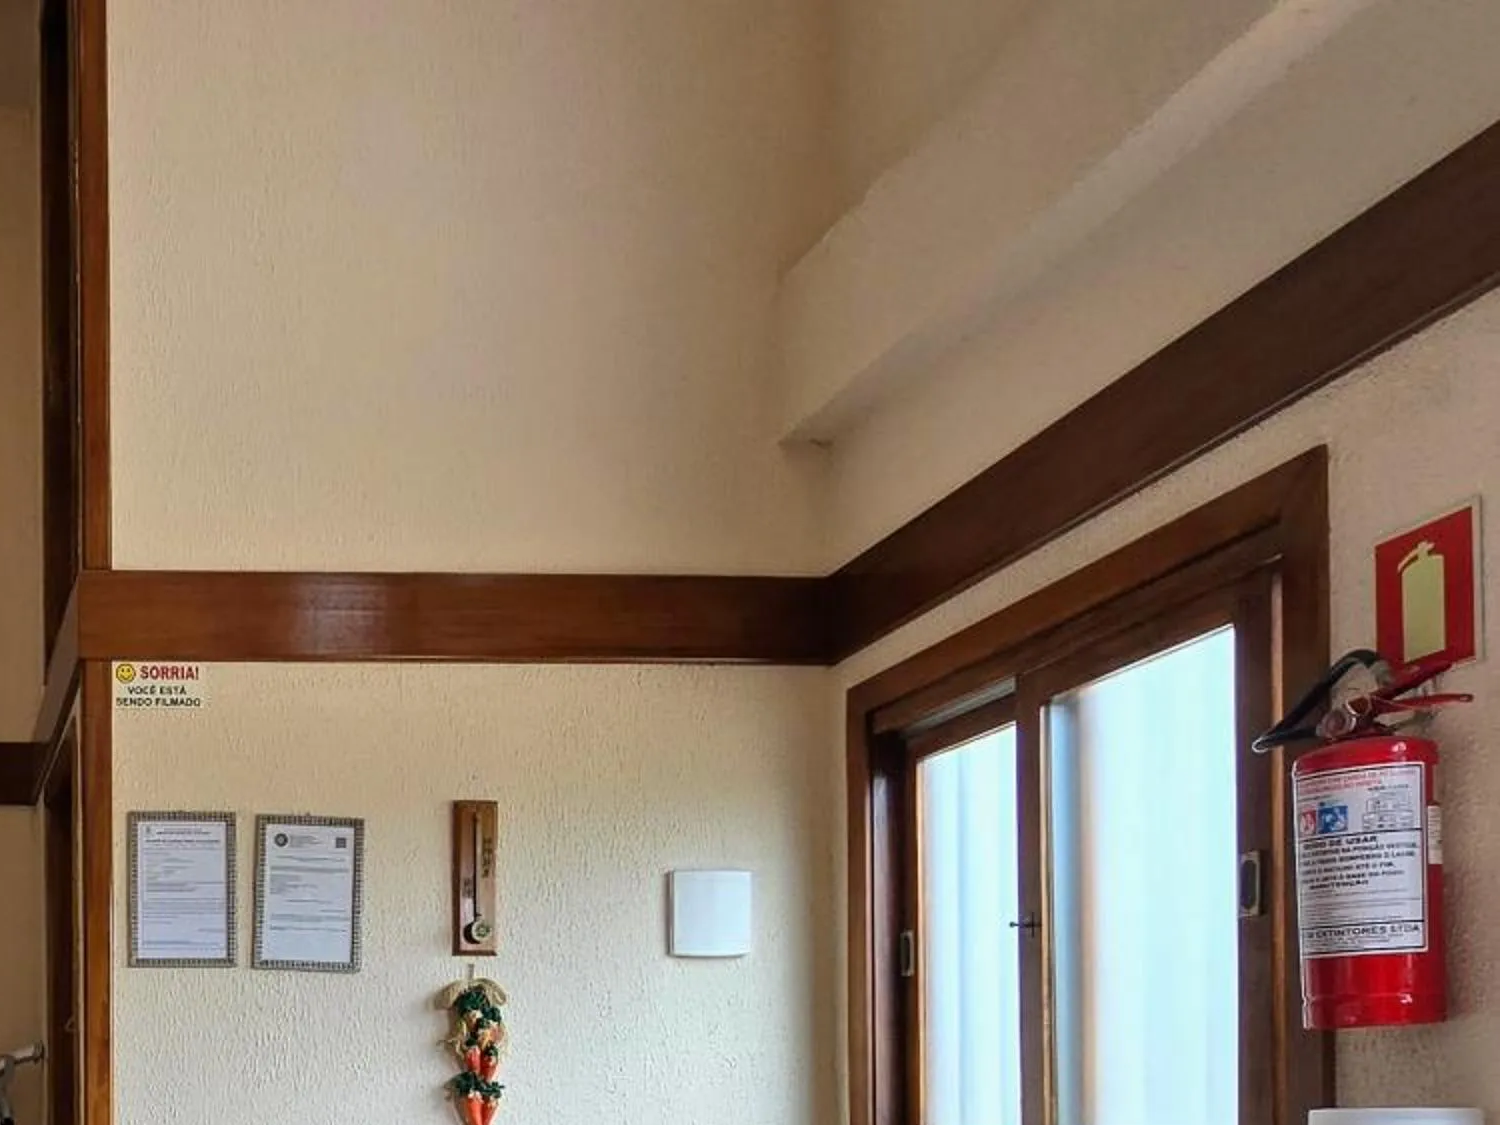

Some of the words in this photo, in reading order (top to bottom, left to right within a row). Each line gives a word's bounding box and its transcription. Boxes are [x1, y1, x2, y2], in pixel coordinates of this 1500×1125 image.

[140, 665, 199, 680] SORRIA!
[128, 685, 157, 695] VOCÊ
[116, 697, 153, 706] SENDO
[155, 697, 201, 706] FILMADO
